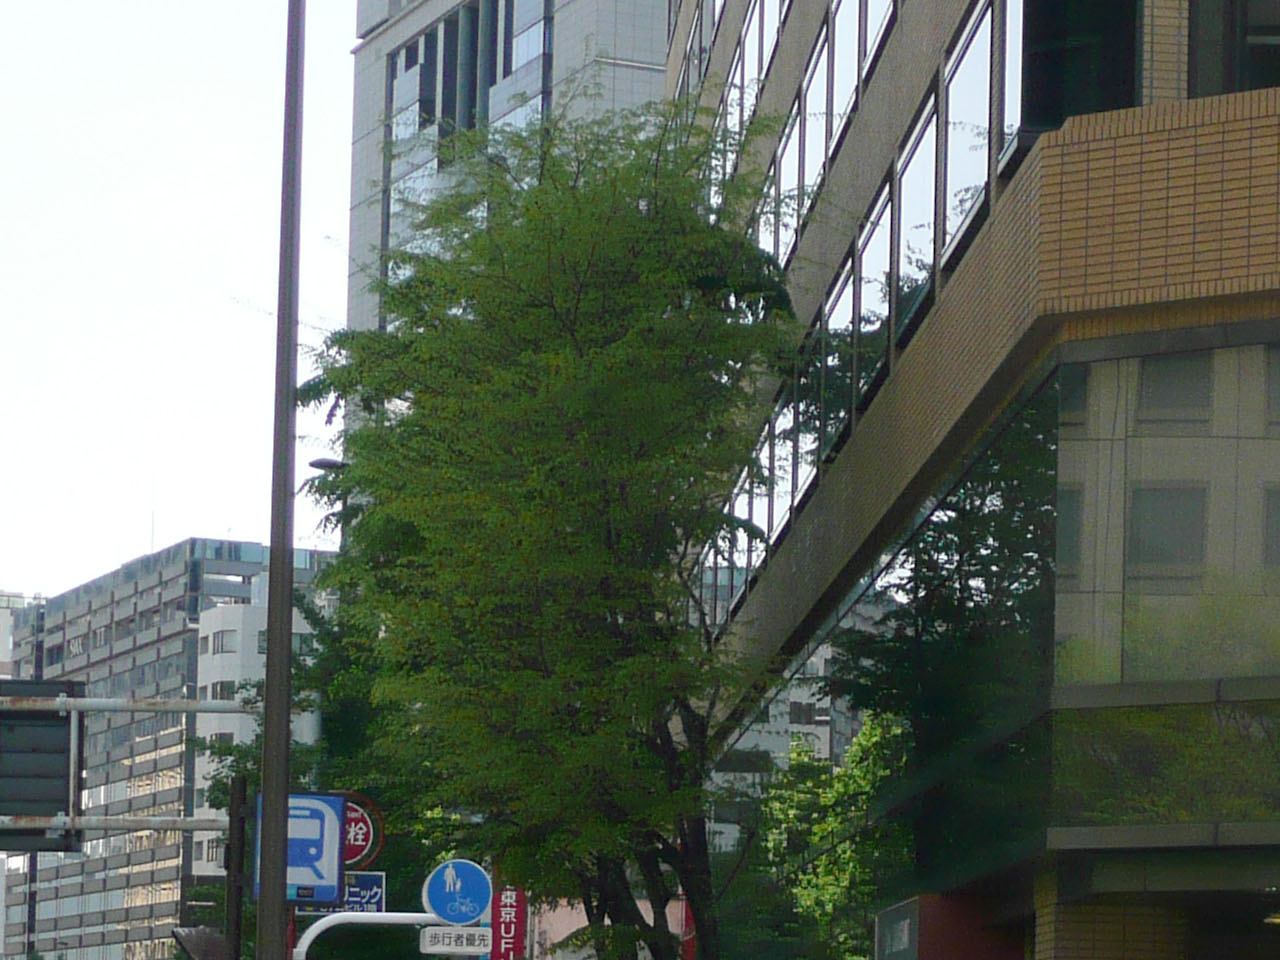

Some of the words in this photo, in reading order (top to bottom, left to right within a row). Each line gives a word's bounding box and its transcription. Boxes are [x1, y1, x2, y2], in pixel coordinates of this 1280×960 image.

[345, 821, 368, 846] 栓
[429, 933, 489, 948] 歩行者優先
